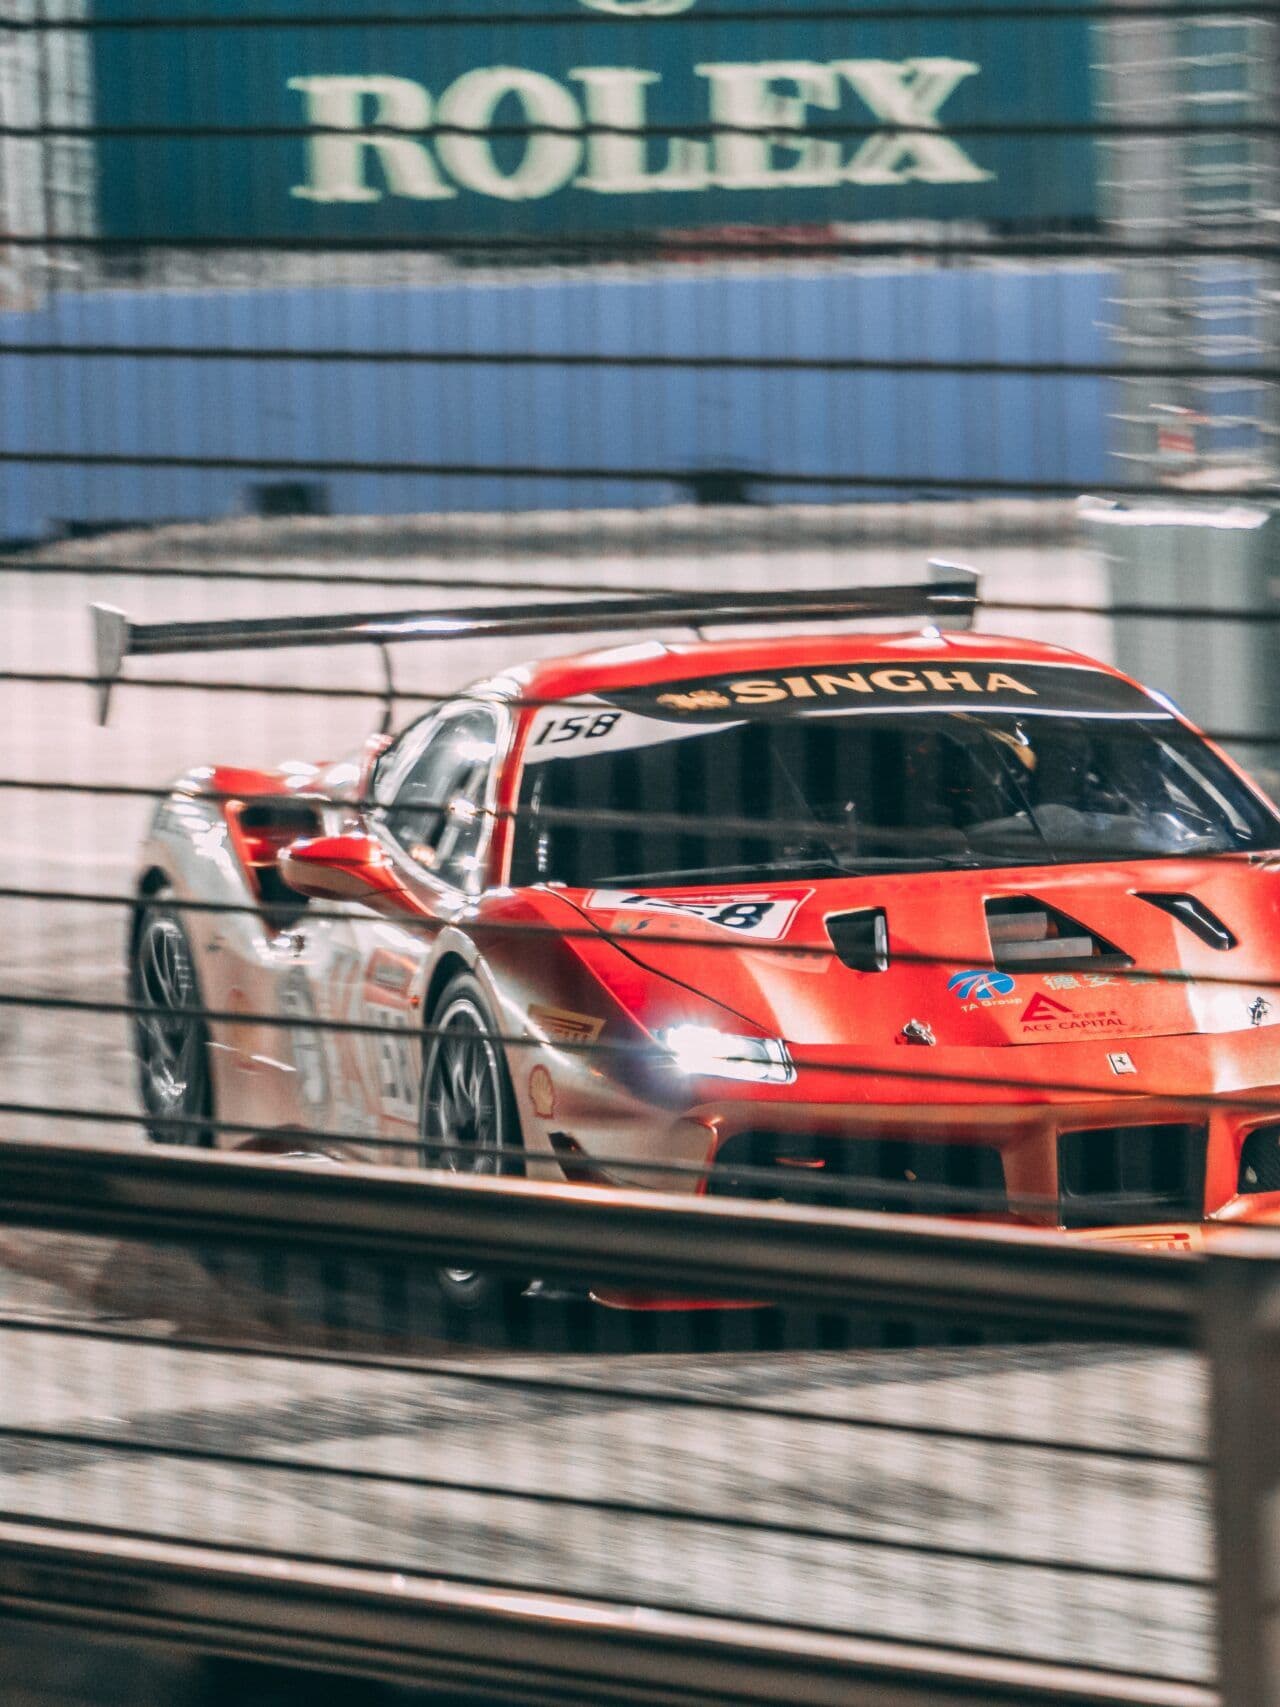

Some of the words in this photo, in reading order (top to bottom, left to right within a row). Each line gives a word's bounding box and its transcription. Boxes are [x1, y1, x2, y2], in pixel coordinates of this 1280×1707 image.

[287, 57, 995, 201] ROLEX
[729, 669, 1038, 703] SINGHA
[534, 712, 622, 745] 158
[1023, 1022, 1051, 1033] ACE
[1058, 1018, 1127, 1031] CAPITAL
